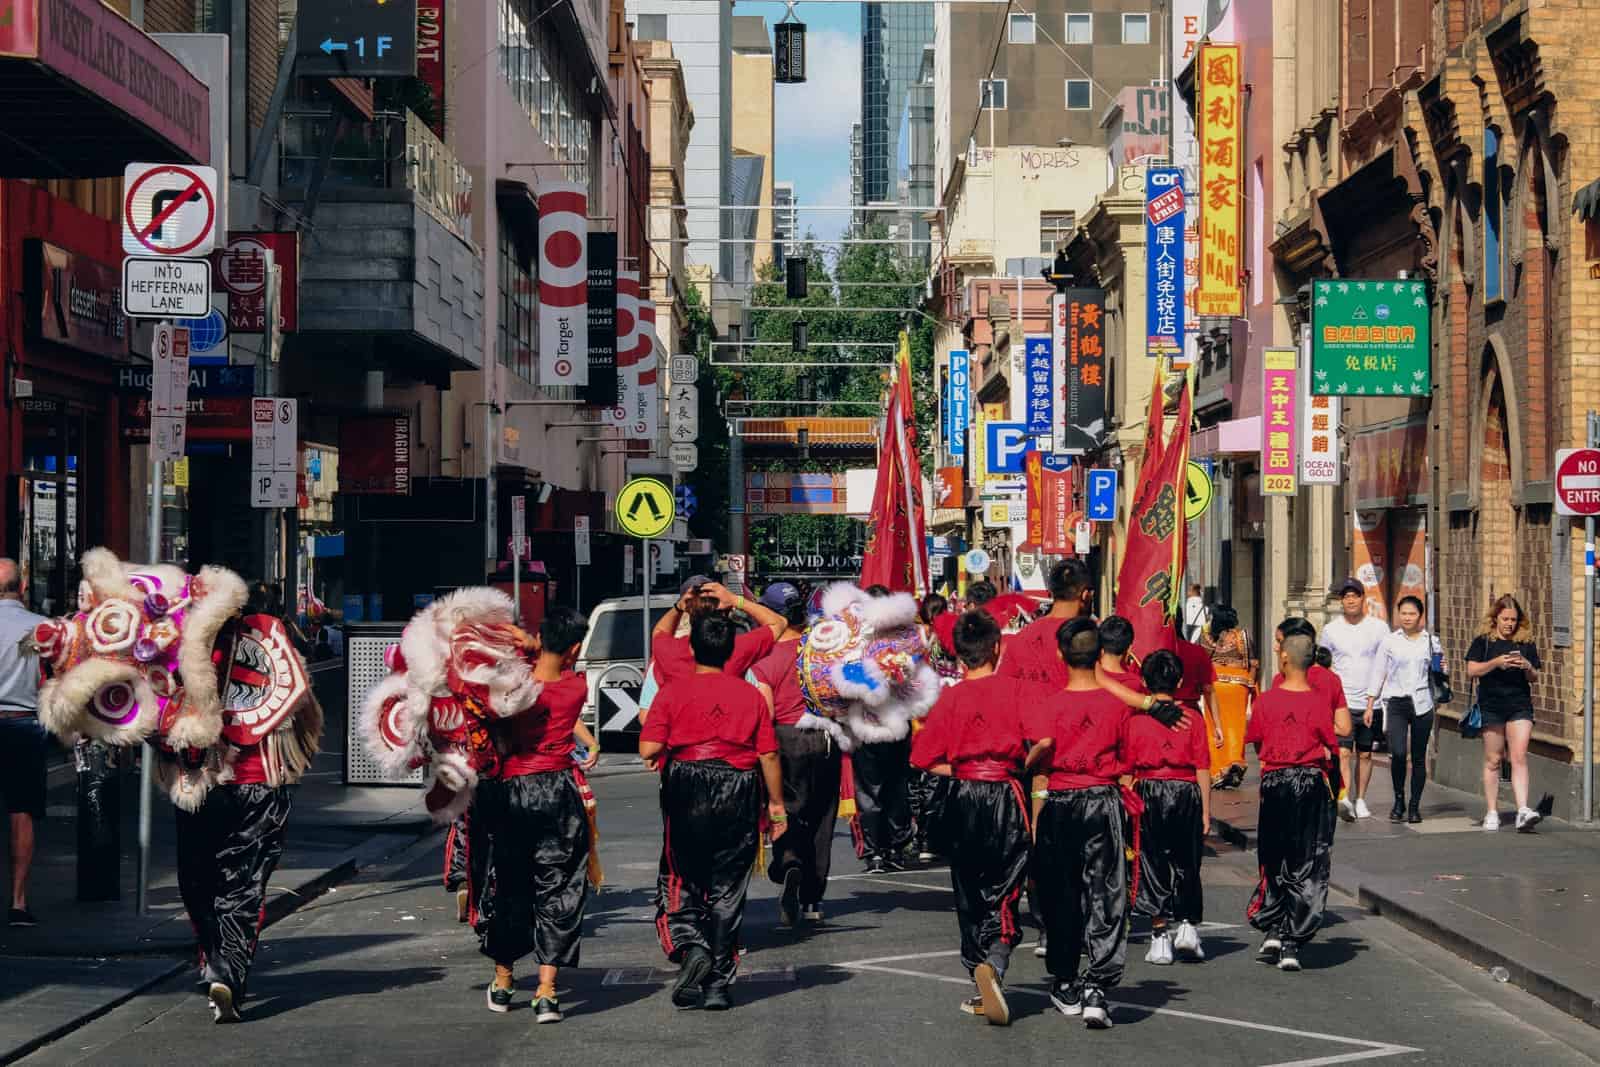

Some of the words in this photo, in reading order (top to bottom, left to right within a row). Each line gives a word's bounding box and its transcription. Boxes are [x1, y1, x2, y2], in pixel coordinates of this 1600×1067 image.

[1152, 191, 1178, 210] DUTY
[1154, 202, 1180, 220] FREE
[1204, 217, 1235, 257] LING
[153, 266, 182, 278] INTO
[1206, 253, 1234, 287] NAN
[131, 281, 203, 294] HEFFERNAN
[151, 297, 184, 309] LANE
[557, 317, 573, 357] Target
[952, 356, 966, 447] POKIES
[395, 417, 409, 462] DRAGON
[996, 429, 1027, 467] P
[1304, 460, 1335, 469] OCEAN
[1308, 469, 1333, 477] GOLD
[1578, 461, 1597, 473] NO
[259, 477, 272, 496] 1P
[395, 467, 409, 496] BOAT
[1095, 477, 1111, 496] P
[1267, 478, 1291, 489] 202
[1567, 490, 1600, 503] ENTR
[780, 554, 824, 568] DAVID
